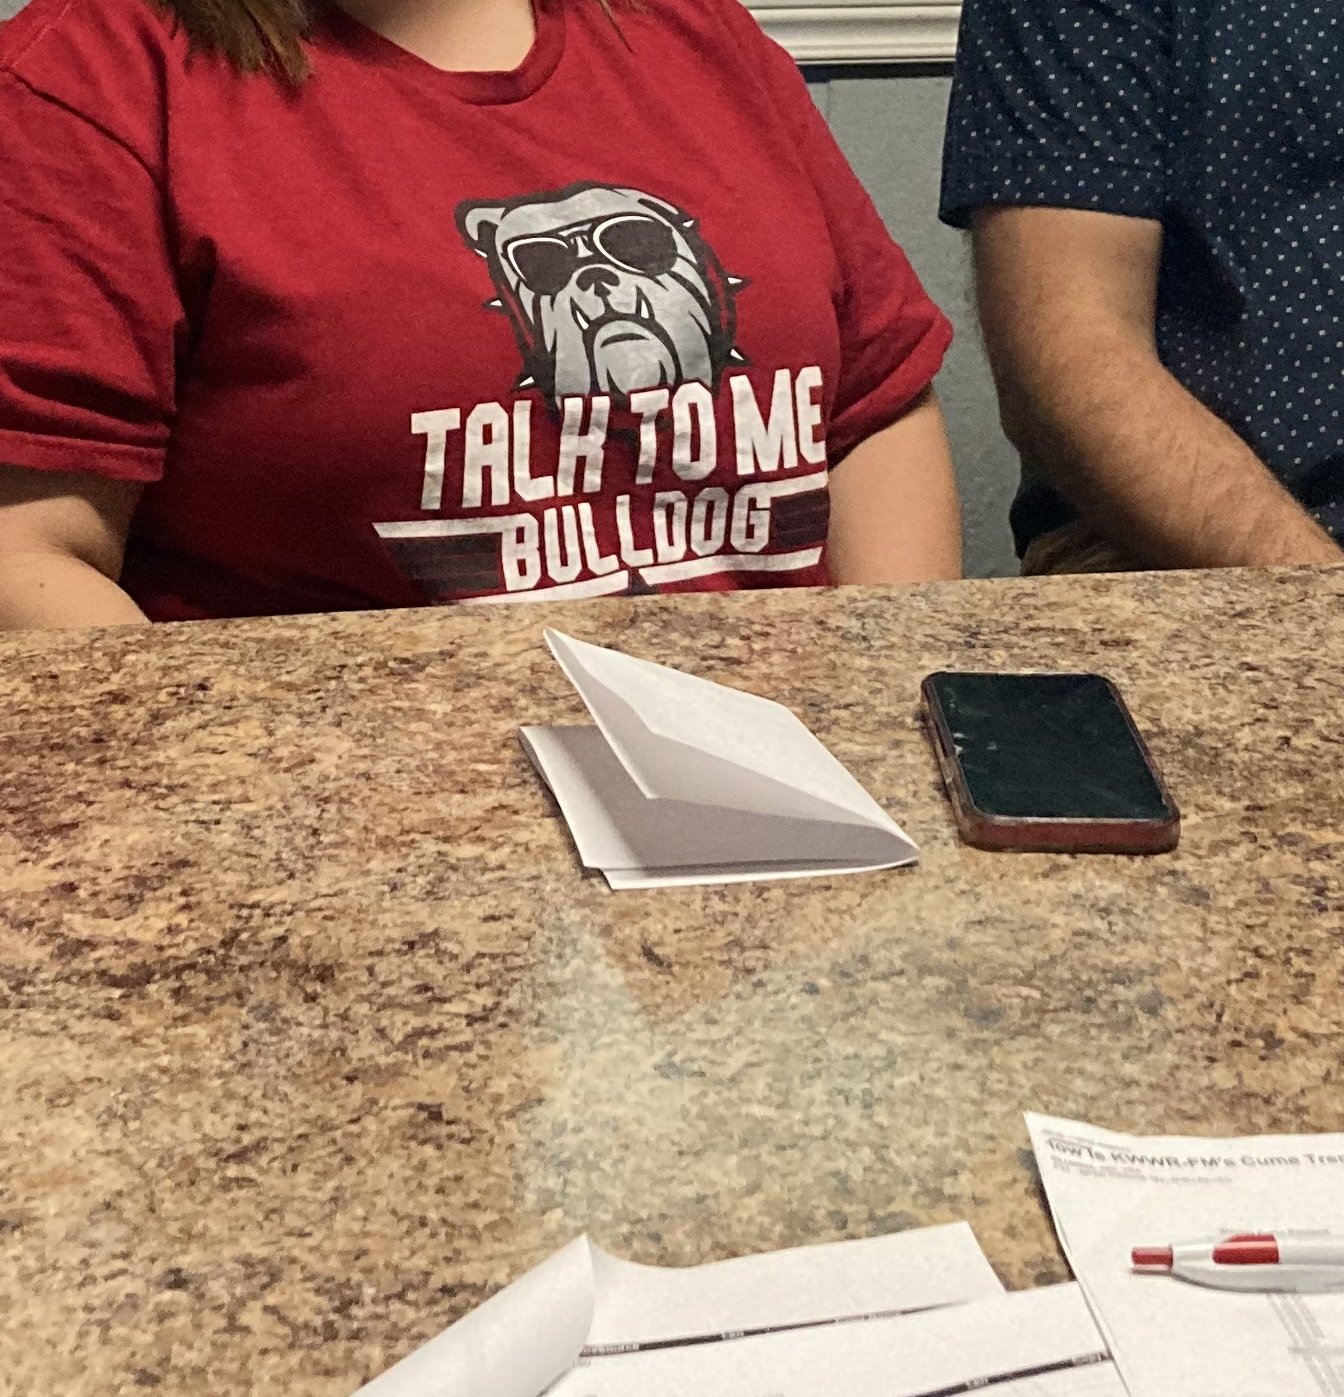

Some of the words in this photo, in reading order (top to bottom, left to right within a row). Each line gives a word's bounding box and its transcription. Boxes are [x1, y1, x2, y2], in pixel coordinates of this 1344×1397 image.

[410, 397, 610, 510] TALK
[629, 382, 717, 486] TO
[730, 366, 827, 477] ME
[501, 481, 771, 593] BULLDOG
